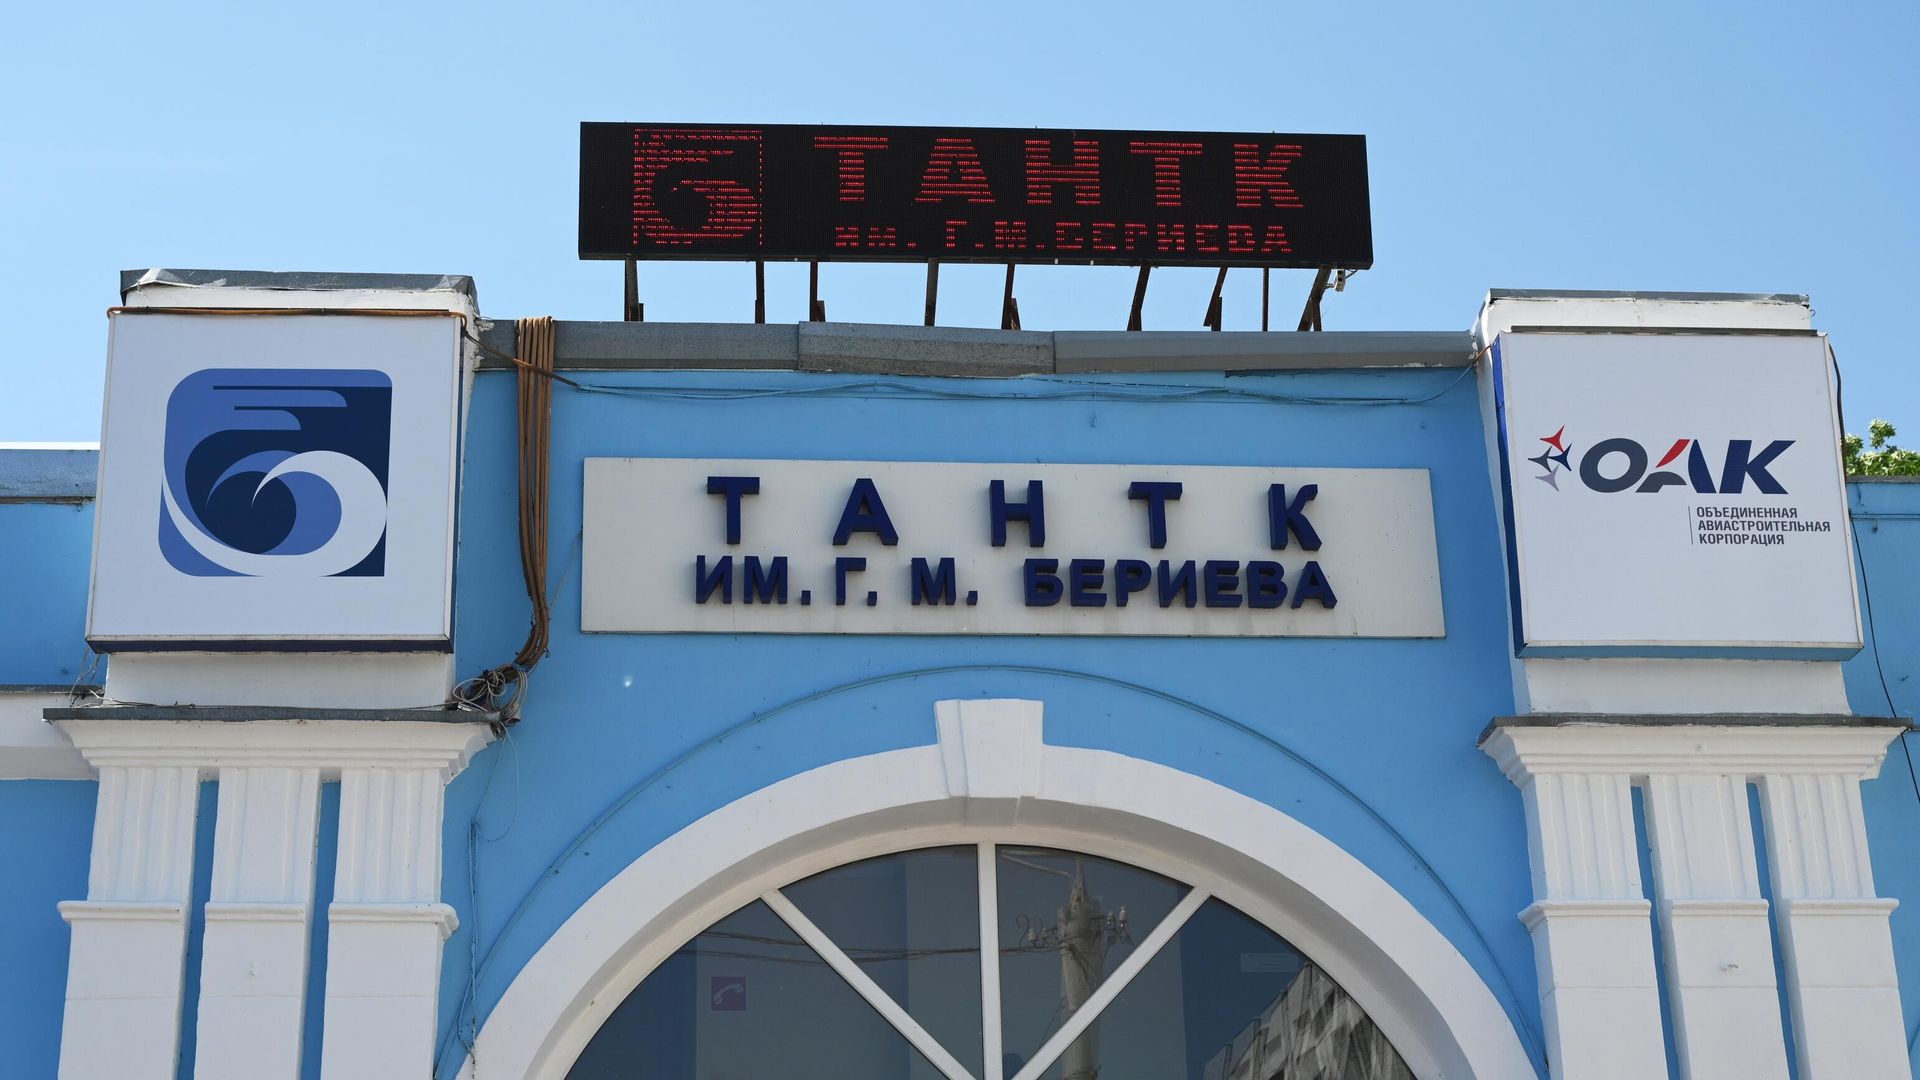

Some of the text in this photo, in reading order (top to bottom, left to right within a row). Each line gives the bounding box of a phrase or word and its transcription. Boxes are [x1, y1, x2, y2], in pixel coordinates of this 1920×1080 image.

[815, 136, 1303, 208] ТАНТК
[1578, 437, 1797, 495] ОАК
[705, 475, 1323, 551] ТАНТК
[1696, 506, 1798, 519] ОБЪЕДИНЕННАЯ
[1698, 519, 1831, 532] АВИАСТРОИТЕЛЬНАЯ
[1699, 533, 1785, 546] КОРПОРАЦИЯ
[694, 554, 1338, 611] ИМ. Г. М. БЕРИЕВА
